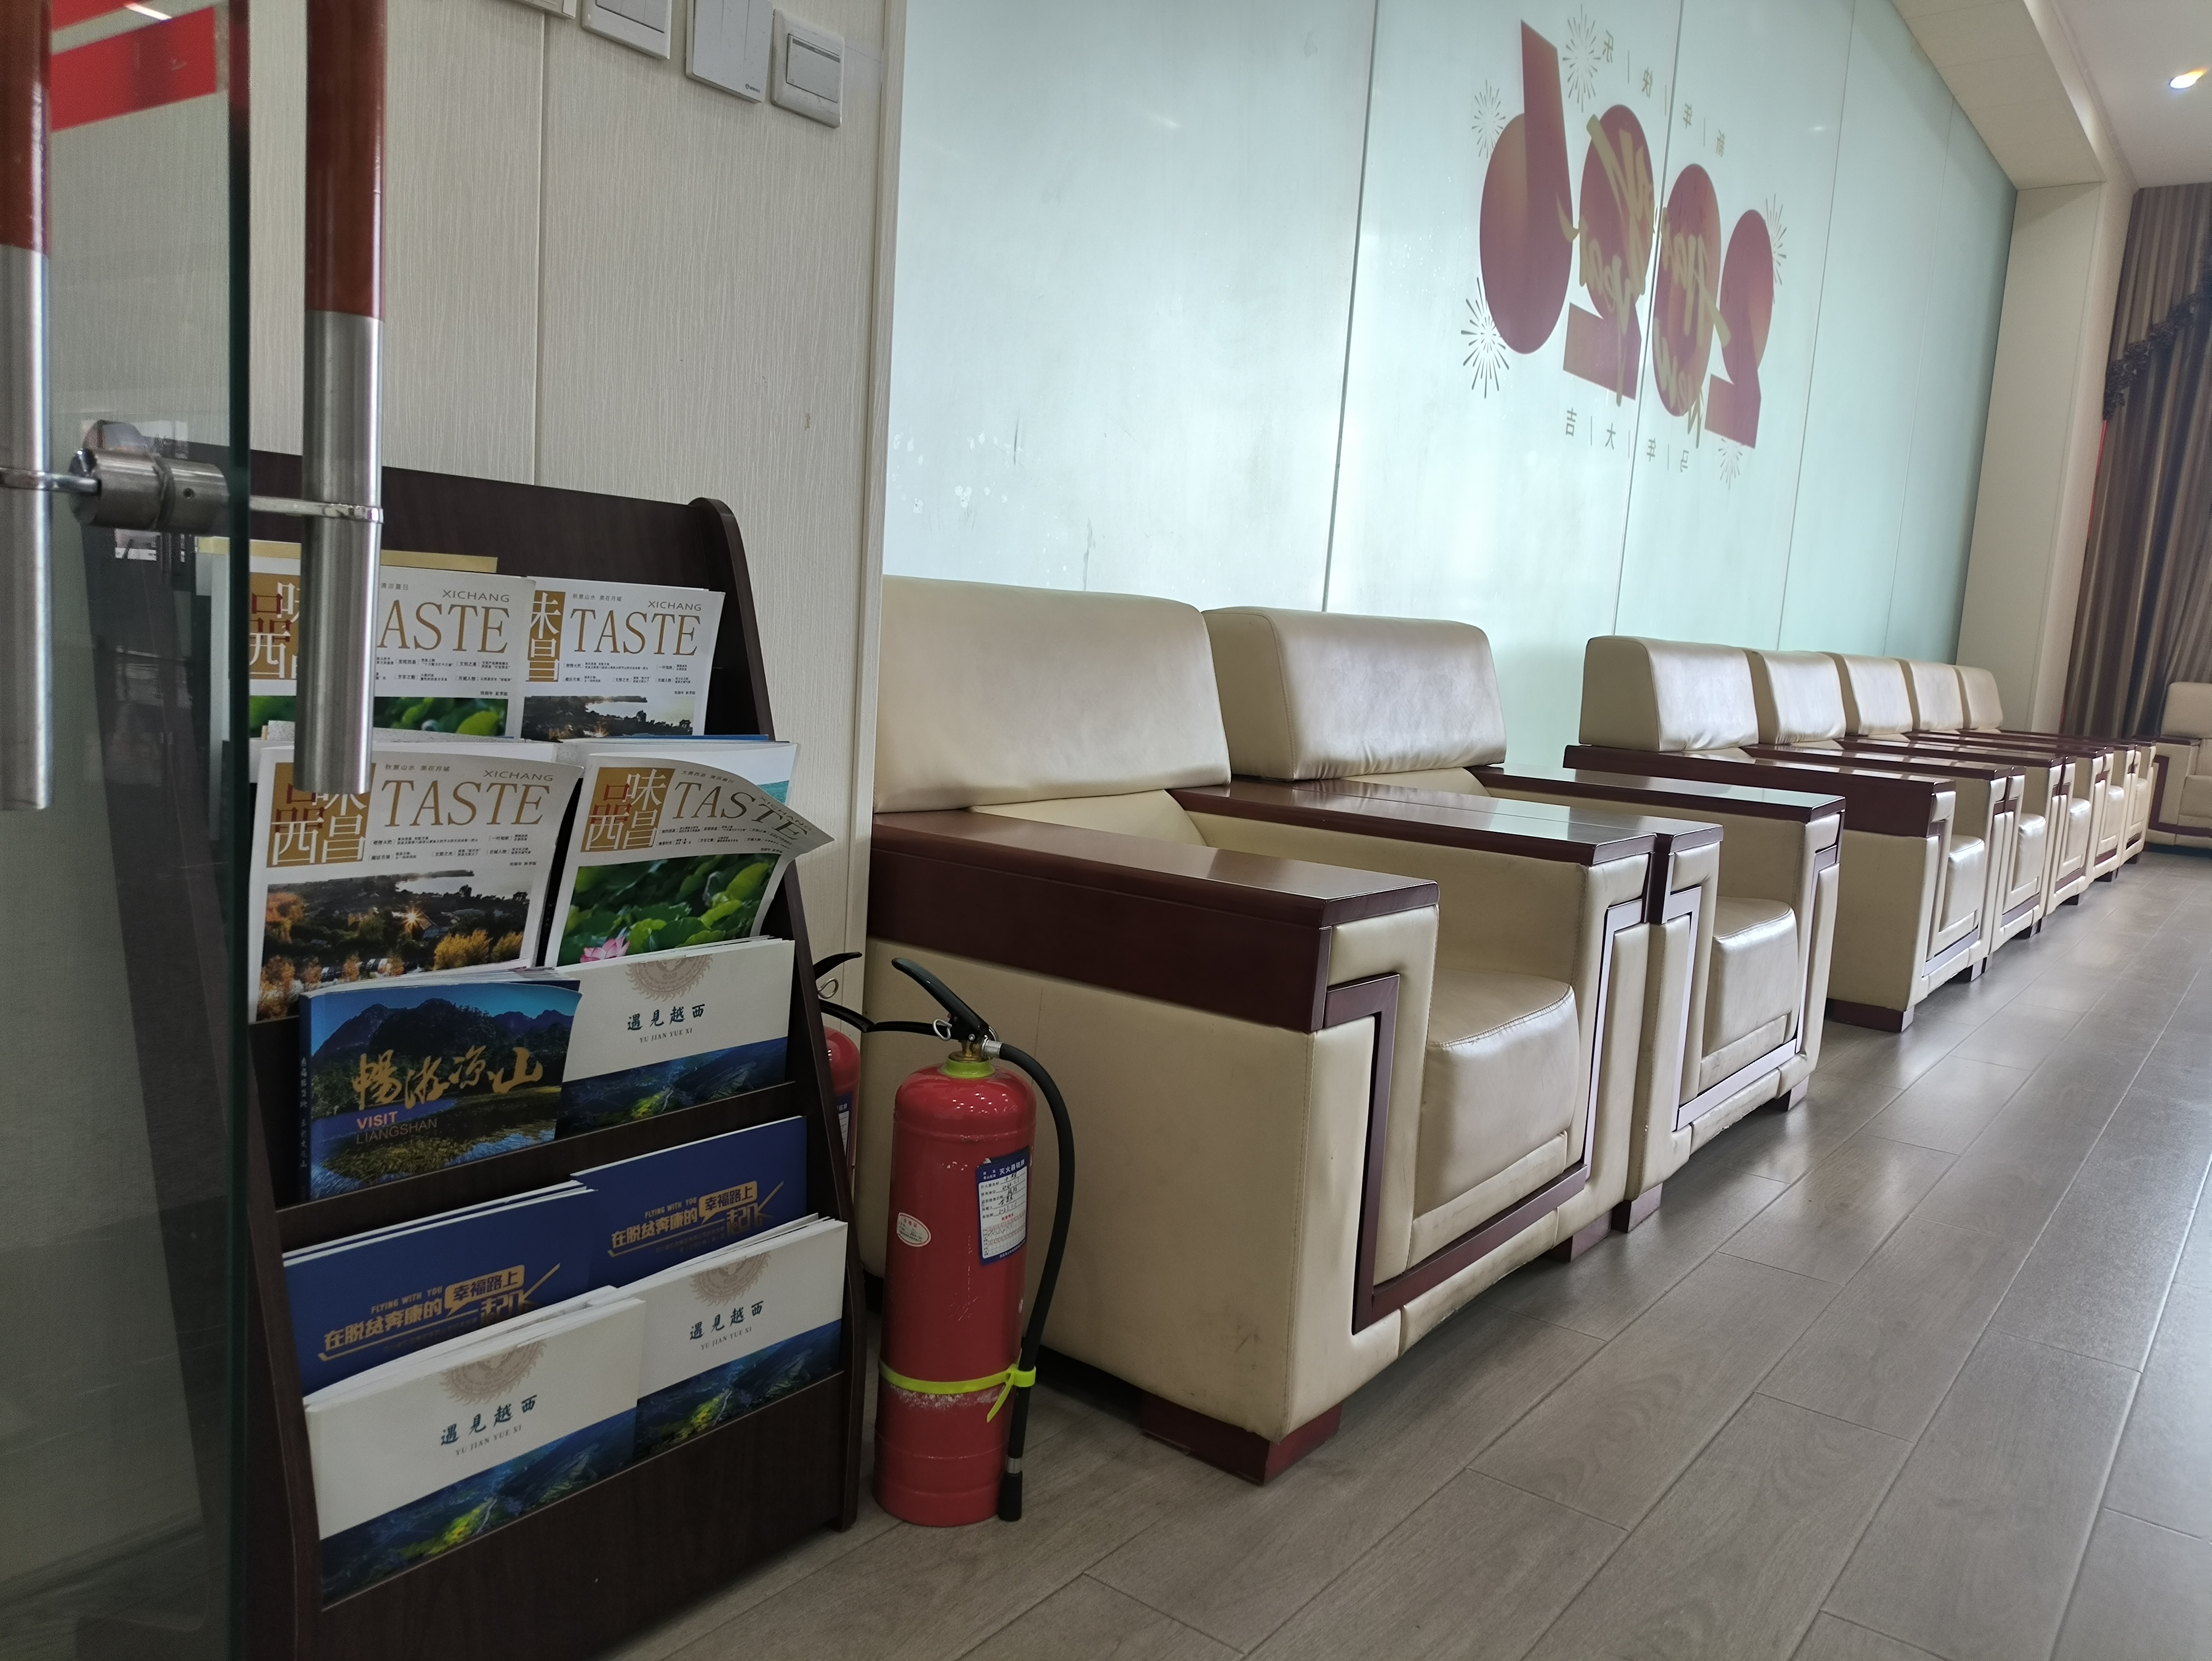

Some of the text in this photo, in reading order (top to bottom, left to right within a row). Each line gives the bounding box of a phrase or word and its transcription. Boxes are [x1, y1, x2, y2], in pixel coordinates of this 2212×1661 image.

[442, 589, 510, 603] XICHANG
[648, 600, 702, 611] XICHANG
[377, 599, 509, 653] ASTE
[570, 608, 700, 656] TASTE
[484, 769, 554, 782] XICHANG
[381, 779, 551, 827] TASTE
[673, 780, 809, 840] TASTE
[759, 796, 813, 831] XICHANG
[627, 1004, 706, 1031] 遇見越西
[651, 1032, 668, 1042] JIAN
[669, 1029, 684, 1038] YUE
[356, 1111, 398, 1129] VISIT
[356, 1118, 438, 1145] LIANGSHAN
[999, 1159, 1025, 1175] 灭火器铭牌
[645, 1196, 697, 1219] FLYING WITH YOU
[704, 1185, 754, 1211] 幸福路上
[611, 1207, 698, 1249] 在脱贫奔康的
[371, 1286, 443, 1314] FLYING WITH YOU
[453, 1270, 519, 1303] 幸福路上
[324, 1297, 442, 1351] 在脱贫奔康的
[689, 1300, 764, 1340] 遇見越西
[700, 1326, 752, 1351] YU JIAN YUE XI
[441, 1394, 538, 1446] 遇見越西
[455, 1424, 522, 1455] YU JIAN YUE XI
